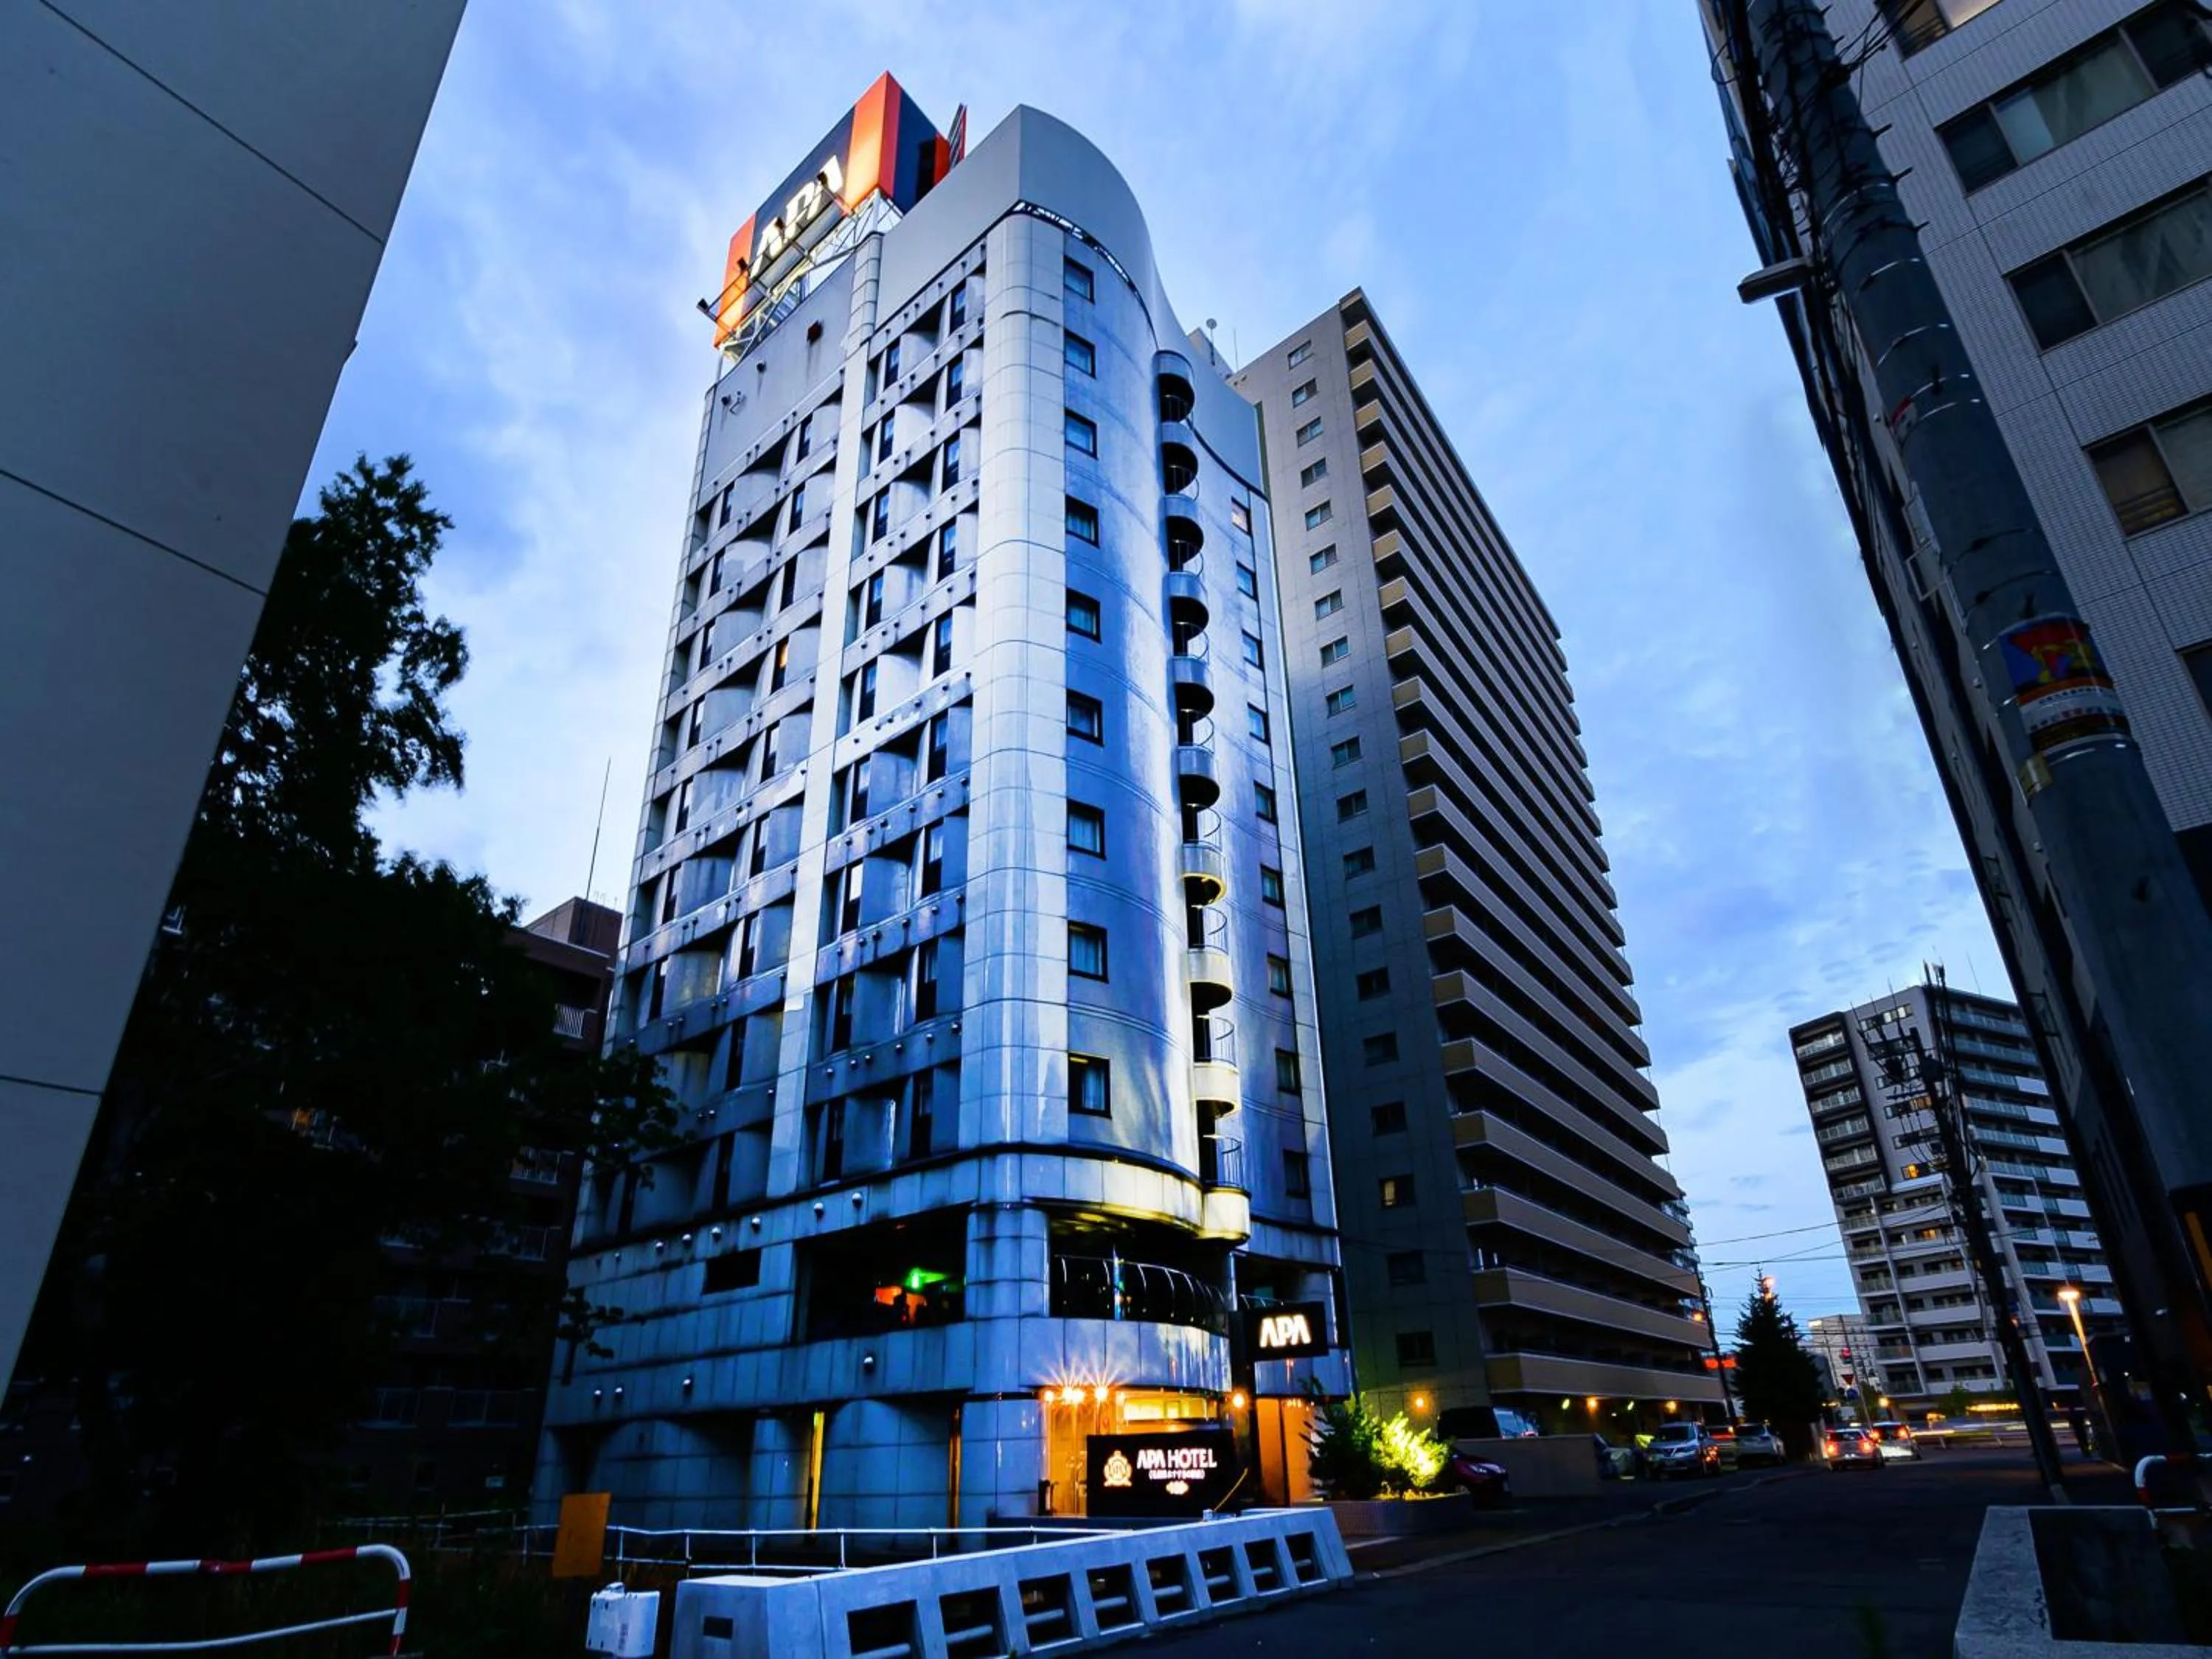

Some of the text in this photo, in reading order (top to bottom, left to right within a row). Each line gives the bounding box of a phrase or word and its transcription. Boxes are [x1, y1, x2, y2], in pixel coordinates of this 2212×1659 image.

[749, 154, 844, 280] APA
[1259, 1314, 1311, 1348] APA
[1136, 1448, 1217, 1469] APA HOTEL
